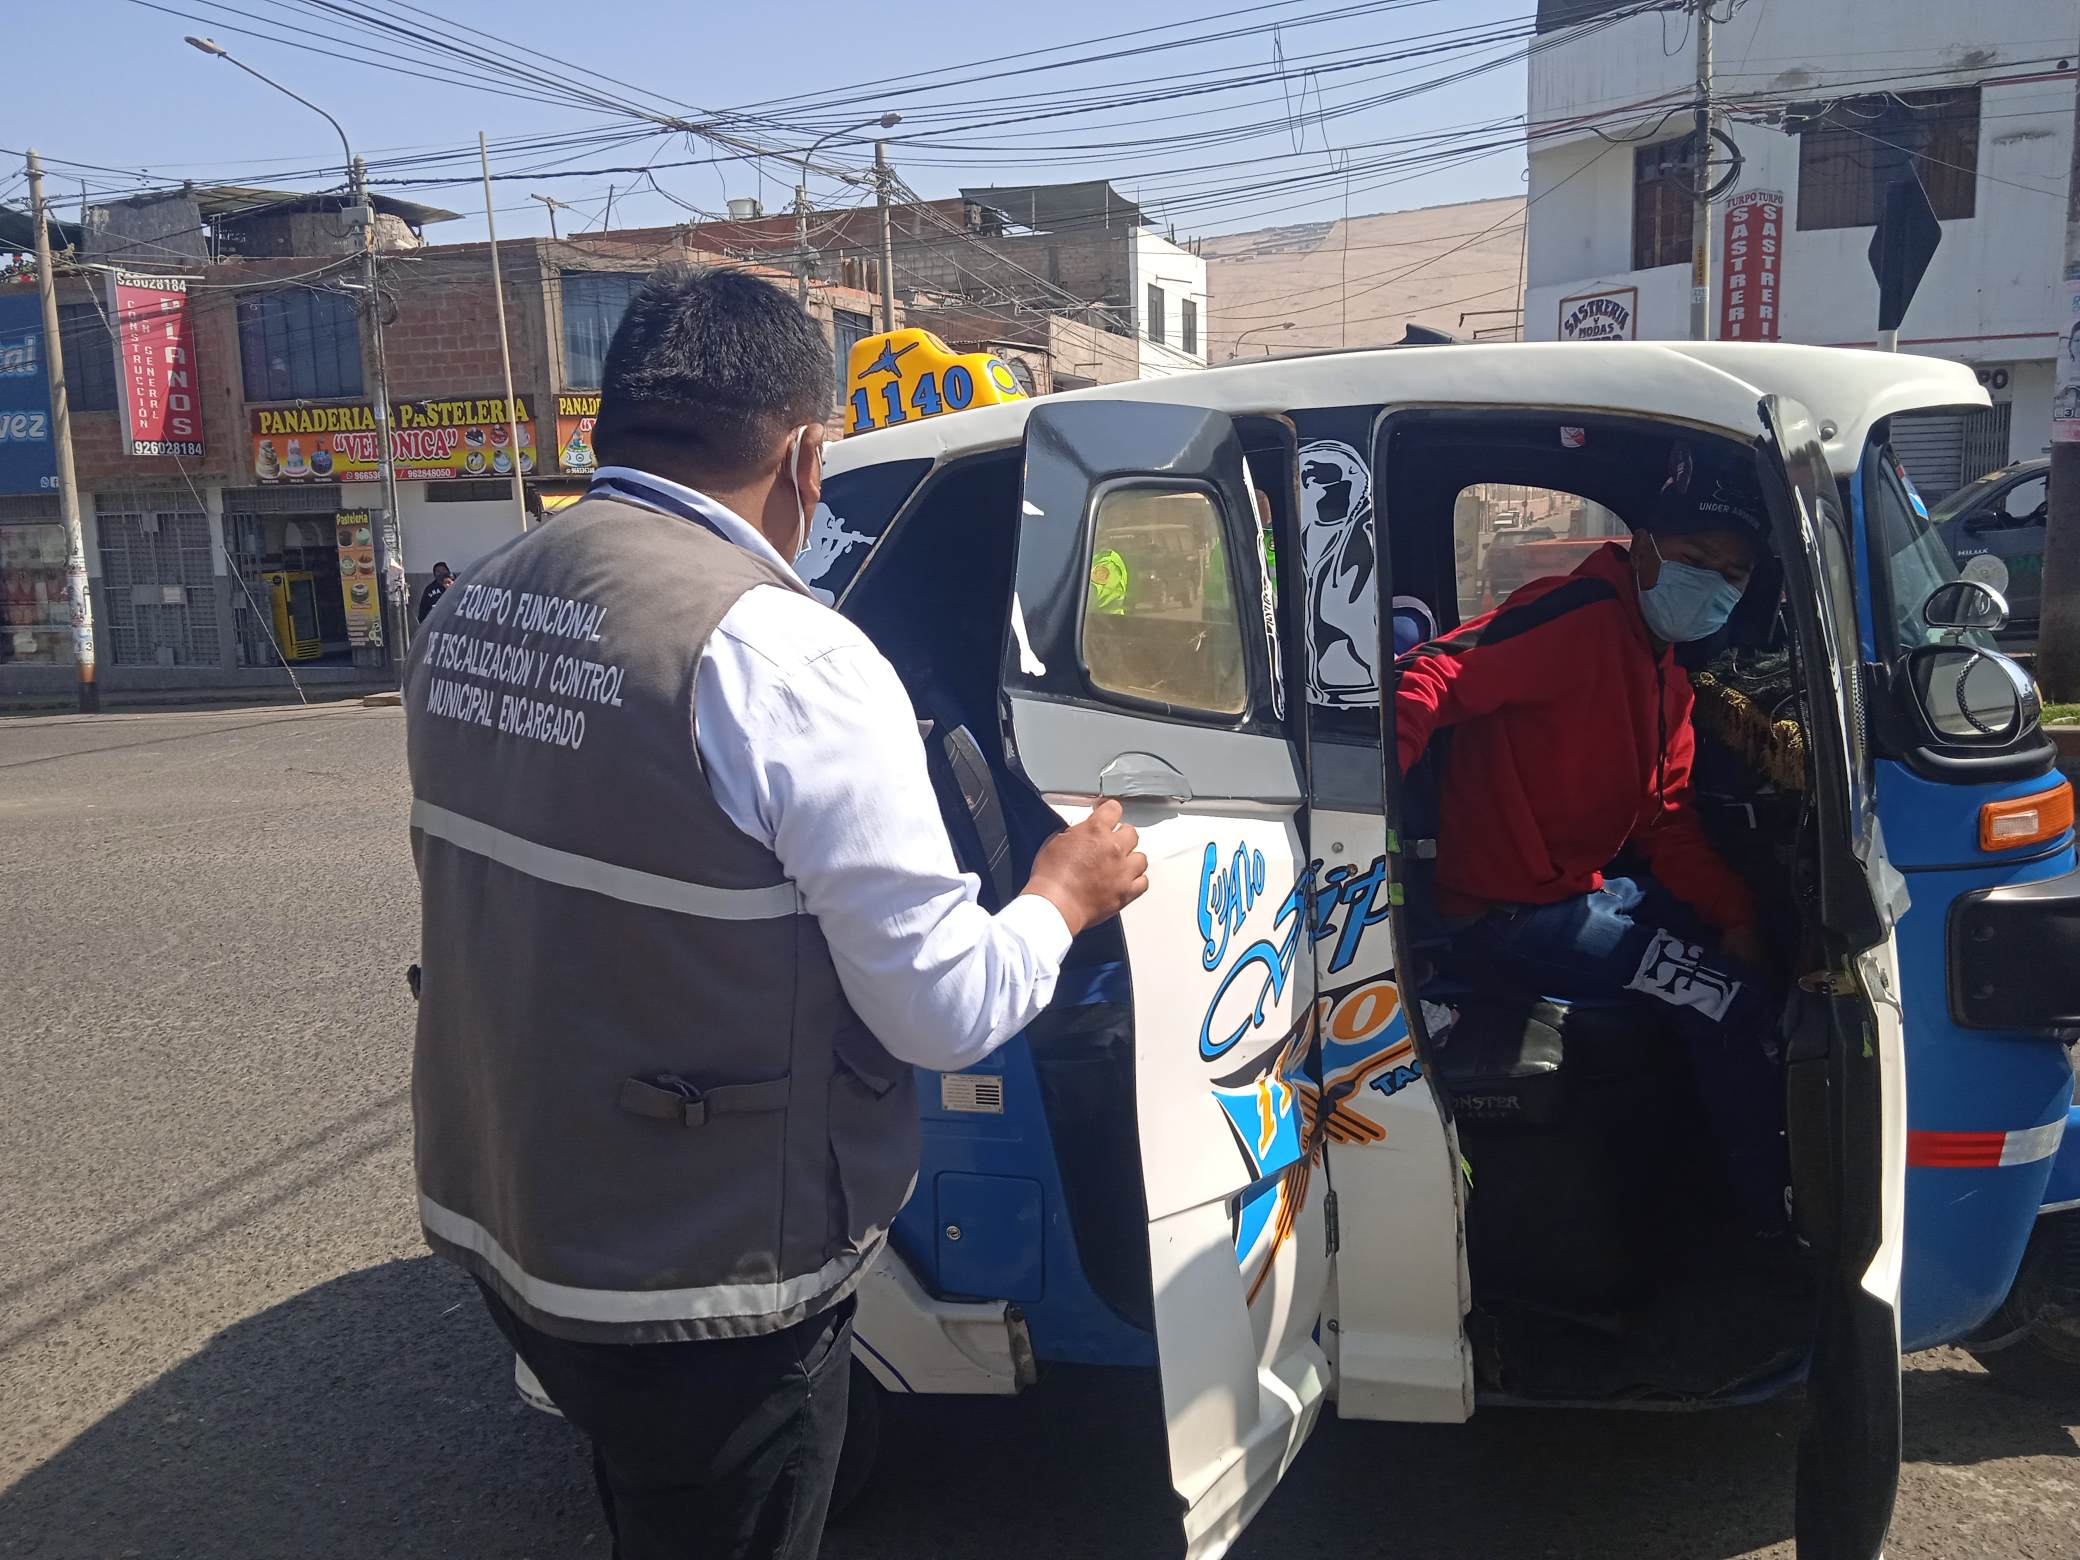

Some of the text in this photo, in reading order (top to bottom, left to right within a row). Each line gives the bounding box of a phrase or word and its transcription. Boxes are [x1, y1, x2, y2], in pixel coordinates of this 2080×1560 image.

[1727, 192, 1757, 209] TURPO
[1759, 191, 1784, 205] TURPO
[1760, 204, 1777, 341] SASTRERI
[1564, 298, 1630, 337] SASTRERIA
[1579, 323, 1614, 338] MODAS
[1593, 316, 1600, 325] Y
[160, 298, 193, 436] PLANOS
[259, 407, 376, 434] PANADERIA
[400, 399, 529, 428] PASTELERIA
[851, 365, 973, 431] 1140
[135, 441, 202, 455] 926028184
[1699, 502, 1730, 512] UNDER
[454, 585, 607, 642] EQUIPO FUNCIONAL
[435, 633, 535, 686] FISCALIZACIÓN
[535, 652, 549, 688] Y
[550, 654, 625, 707] CONTROL
[427, 678, 585, 750] MUNICIPAL ENCARGADO
